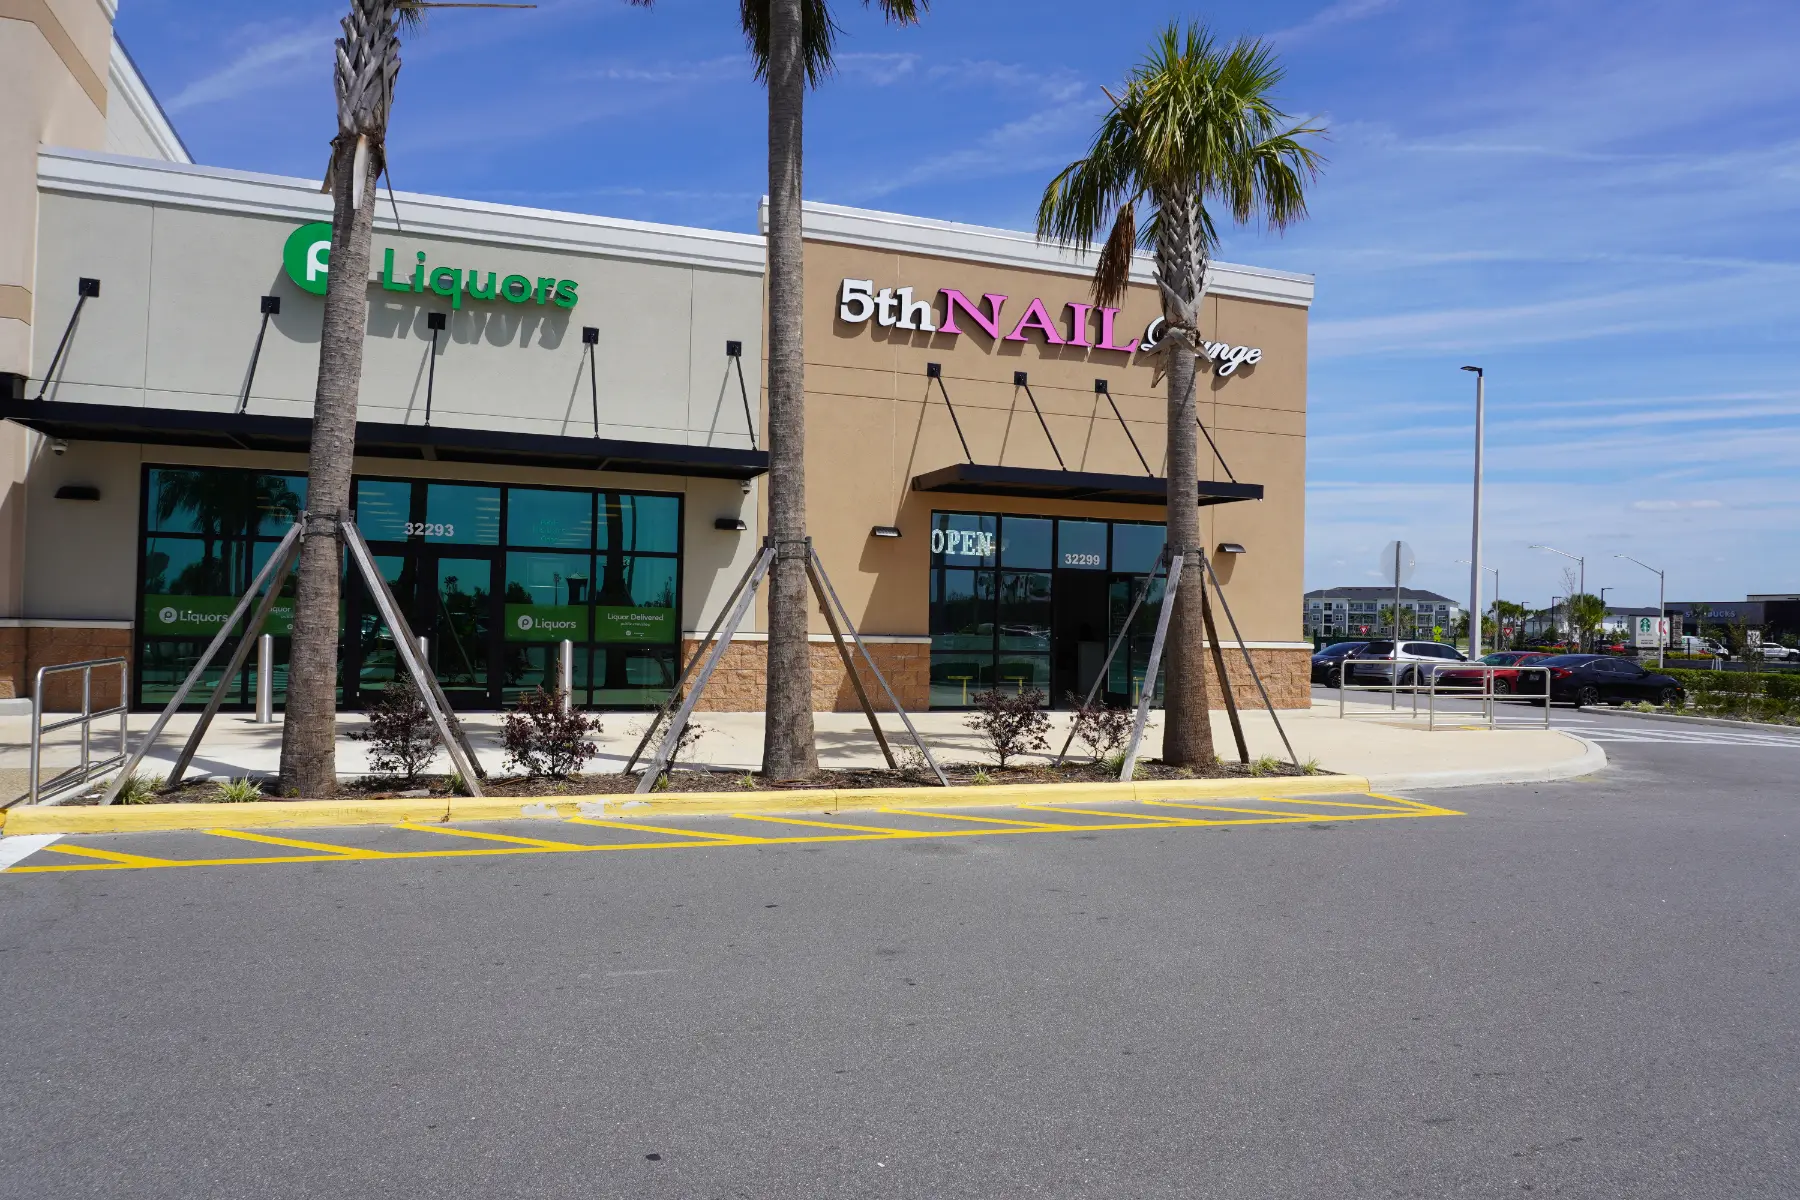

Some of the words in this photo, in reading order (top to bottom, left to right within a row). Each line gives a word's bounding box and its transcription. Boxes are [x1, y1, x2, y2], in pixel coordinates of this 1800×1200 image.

[383, 247, 579, 310] Liquors
[839, 278, 936, 332] 5th
[937, 288, 1140, 354] NAIL
[1140, 315, 1263, 377] nge
[404, 522, 455, 537] 32293
[931, 528, 993, 557] OPEN
[1064, 553, 1101, 566] 32299
[270, 606, 292, 614] iquor
[1685, 610, 1737, 618] SBUCKS
[180, 610, 229, 624] Liquors
[607, 613, 630, 621] Liquor
[630, 613, 664, 621] Delivered
[535, 618, 577, 631] Liquors
